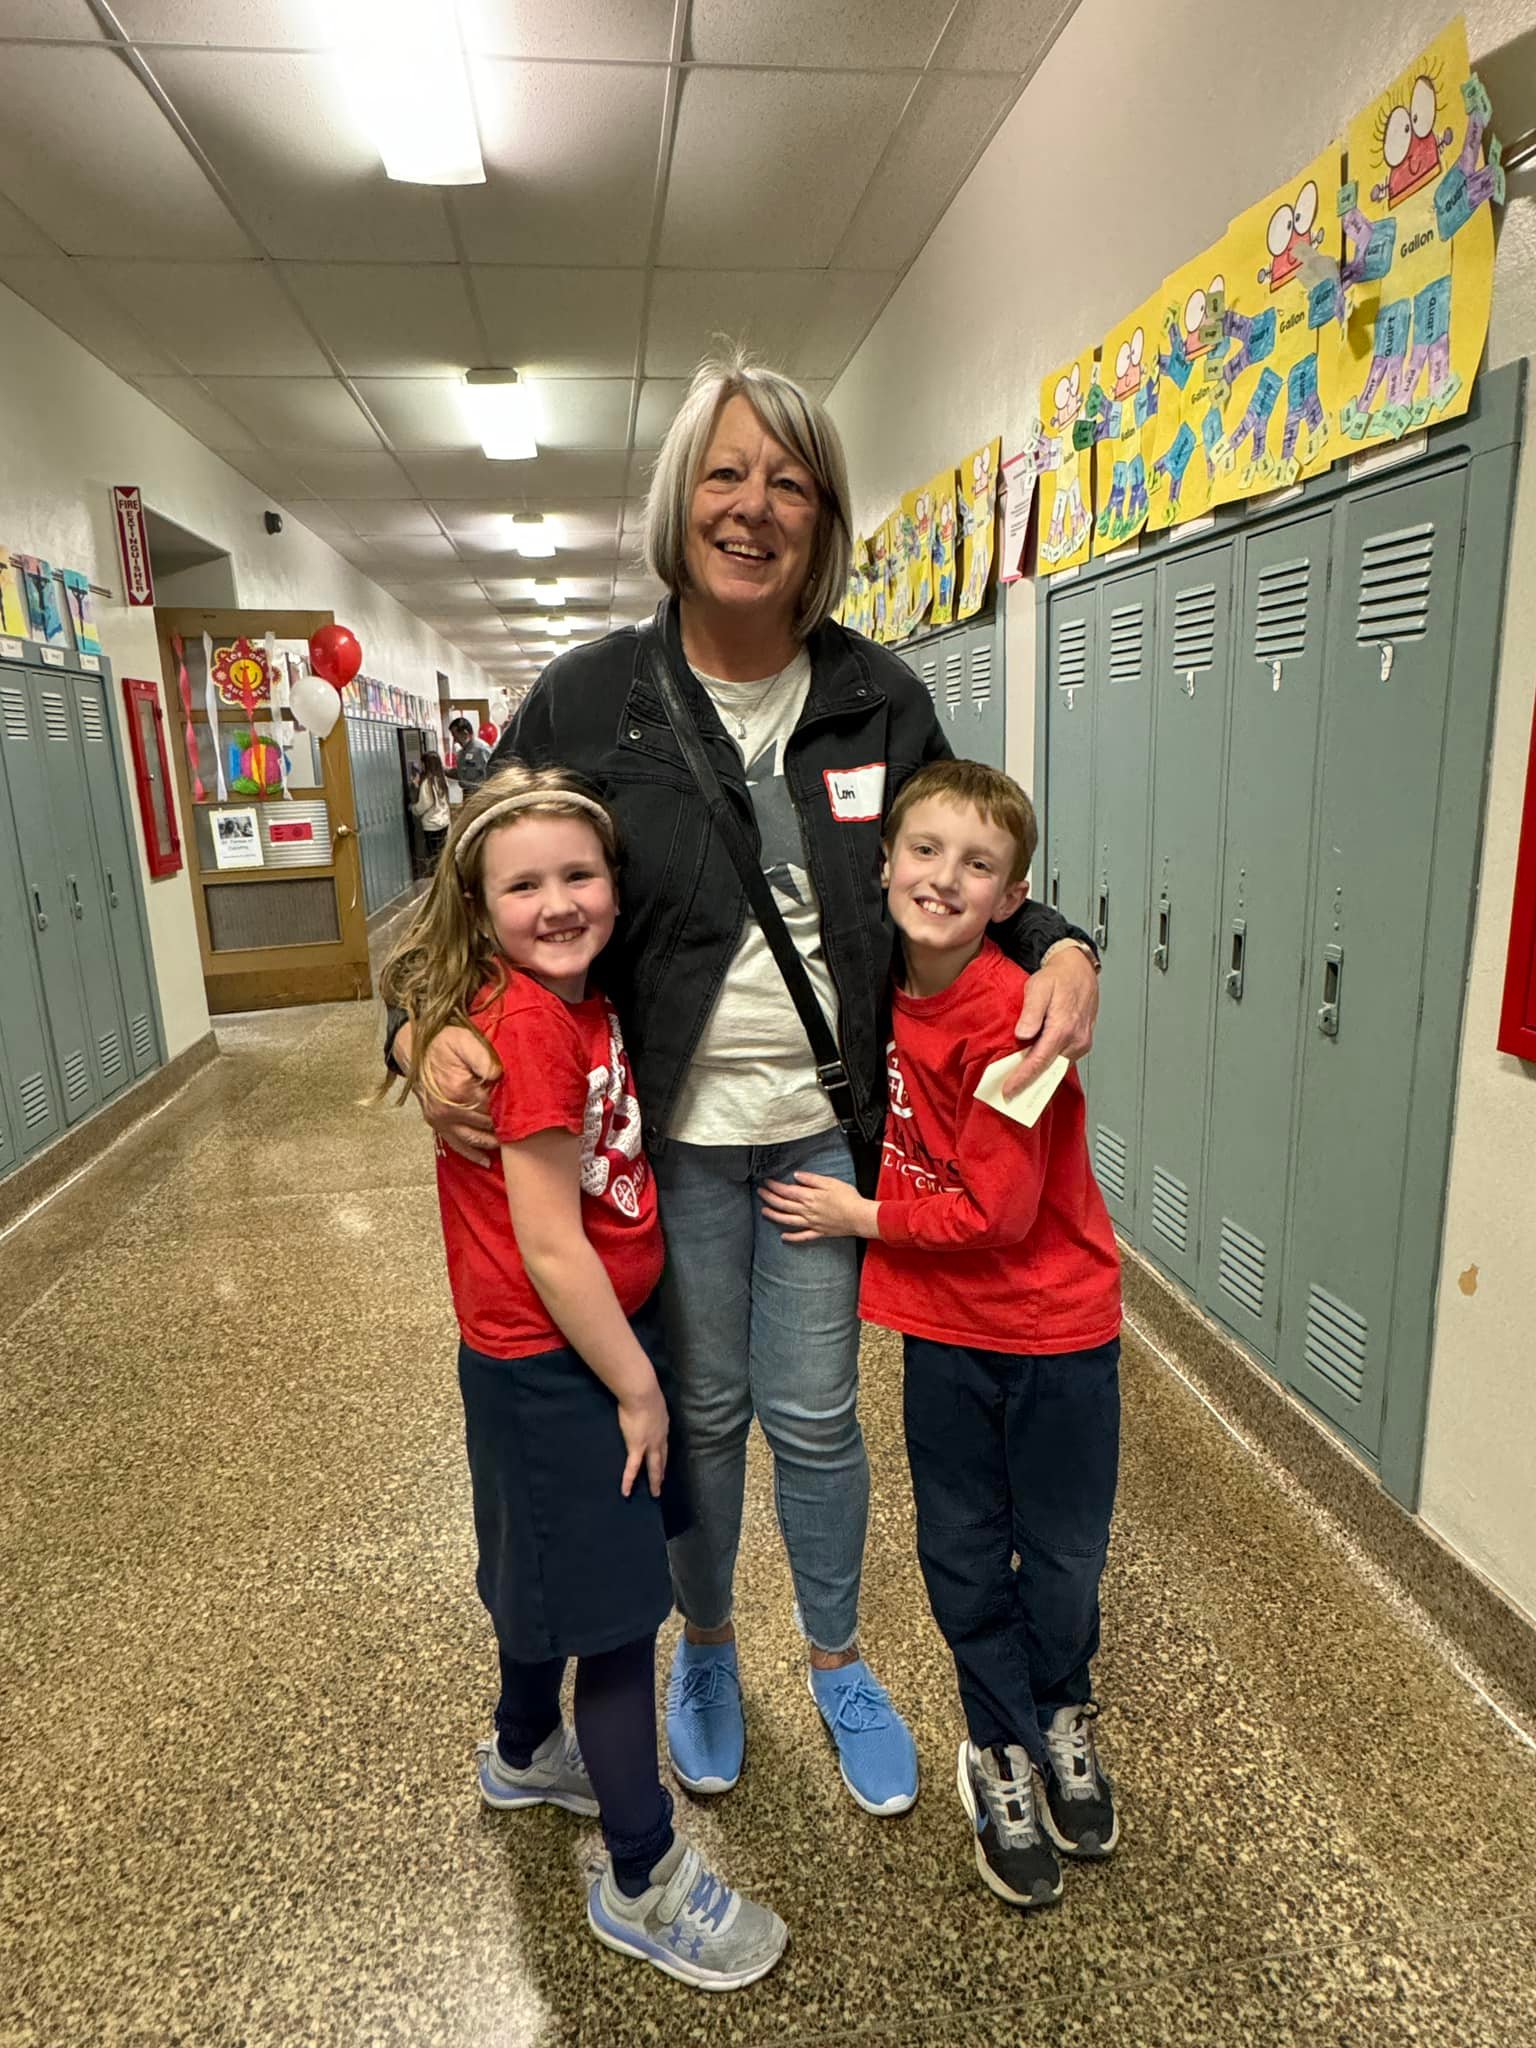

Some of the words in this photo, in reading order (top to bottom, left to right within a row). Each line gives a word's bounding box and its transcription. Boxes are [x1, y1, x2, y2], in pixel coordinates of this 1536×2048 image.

[1400, 229, 1434, 258] Gallon
[1280, 311, 1305, 334] Gallon
[1426, 297, 1437, 339] Quart
[1384, 316, 1396, 357] Quart
[119, 500, 138, 510] FIRE
[126, 510, 144, 593] EXTINGUISHER
